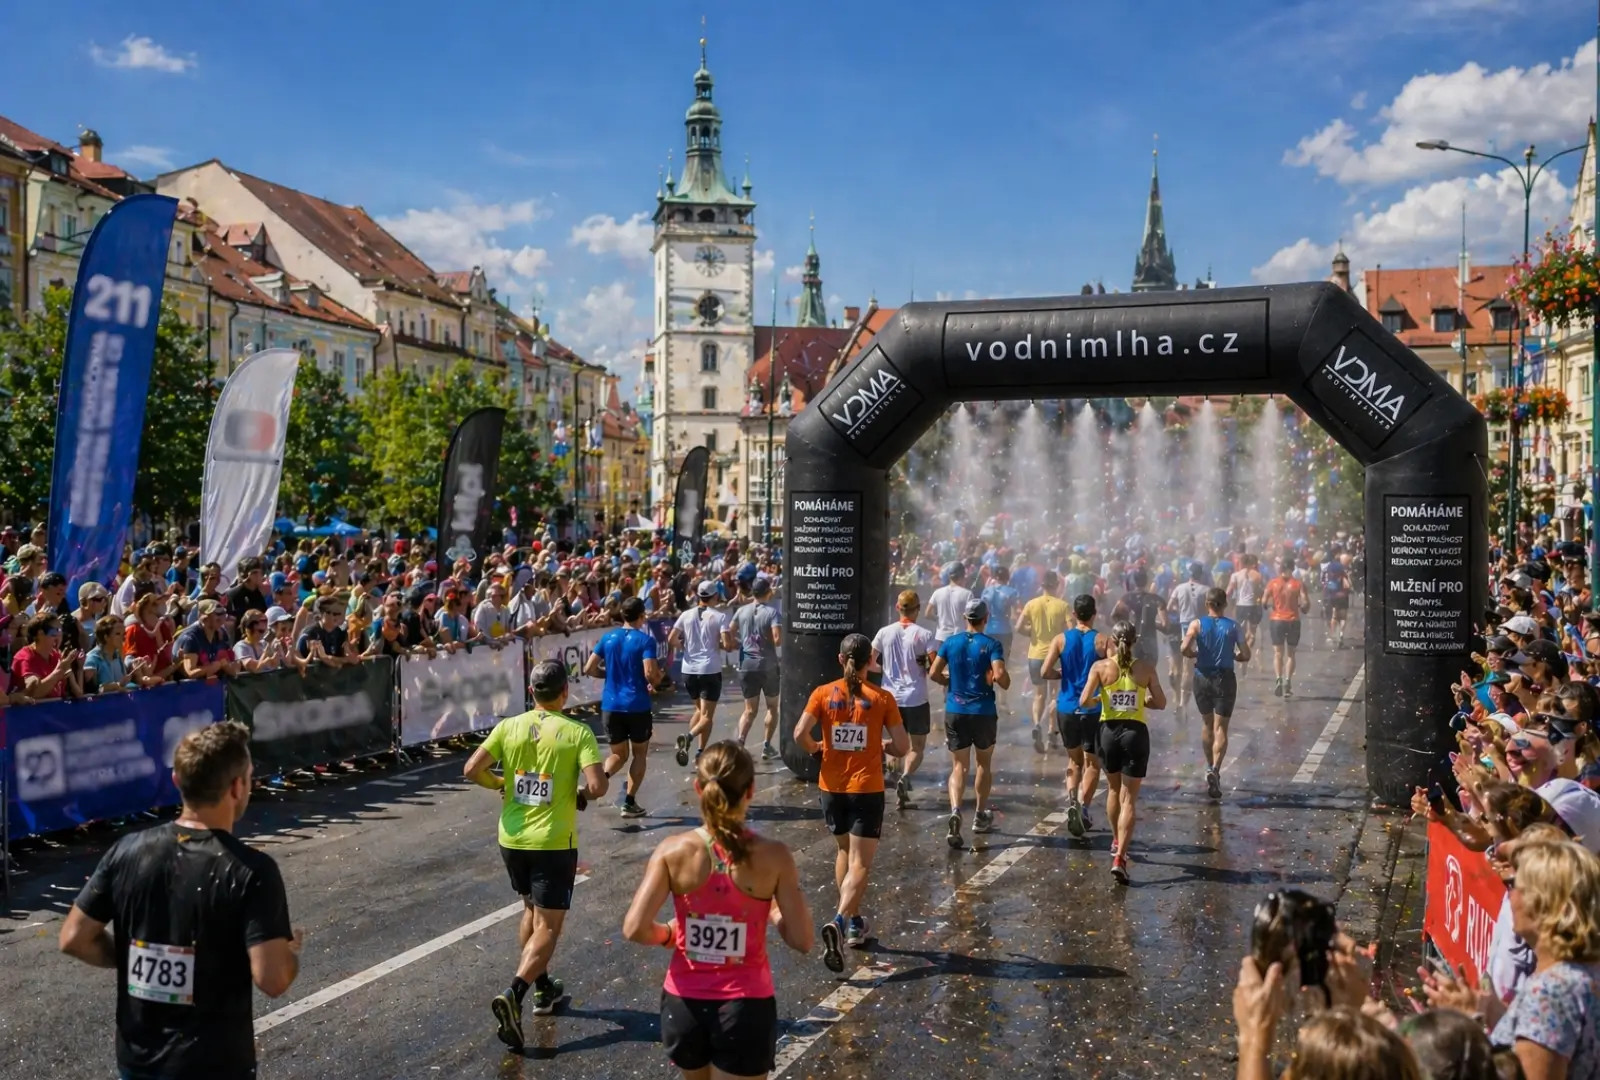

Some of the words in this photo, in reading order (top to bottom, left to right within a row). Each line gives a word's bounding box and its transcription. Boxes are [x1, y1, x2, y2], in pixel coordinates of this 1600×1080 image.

[965, 329, 1239, 361] vodnimlha.cz
[794, 498, 854, 512] POMÁHÁME
[1390, 503, 1463, 518] POMÁHÁME
[793, 563, 830, 578] MLŽENÍ
[832, 567, 854, 577] PRO
[1390, 578, 1436, 593] MLŽENÍ
[1439, 581, 1463, 593] PRO
[834, 729, 864, 743] 5274
[516, 778, 549, 797] 6128
[689, 924, 740, 951] 3921
[131, 955, 187, 988] 4783
